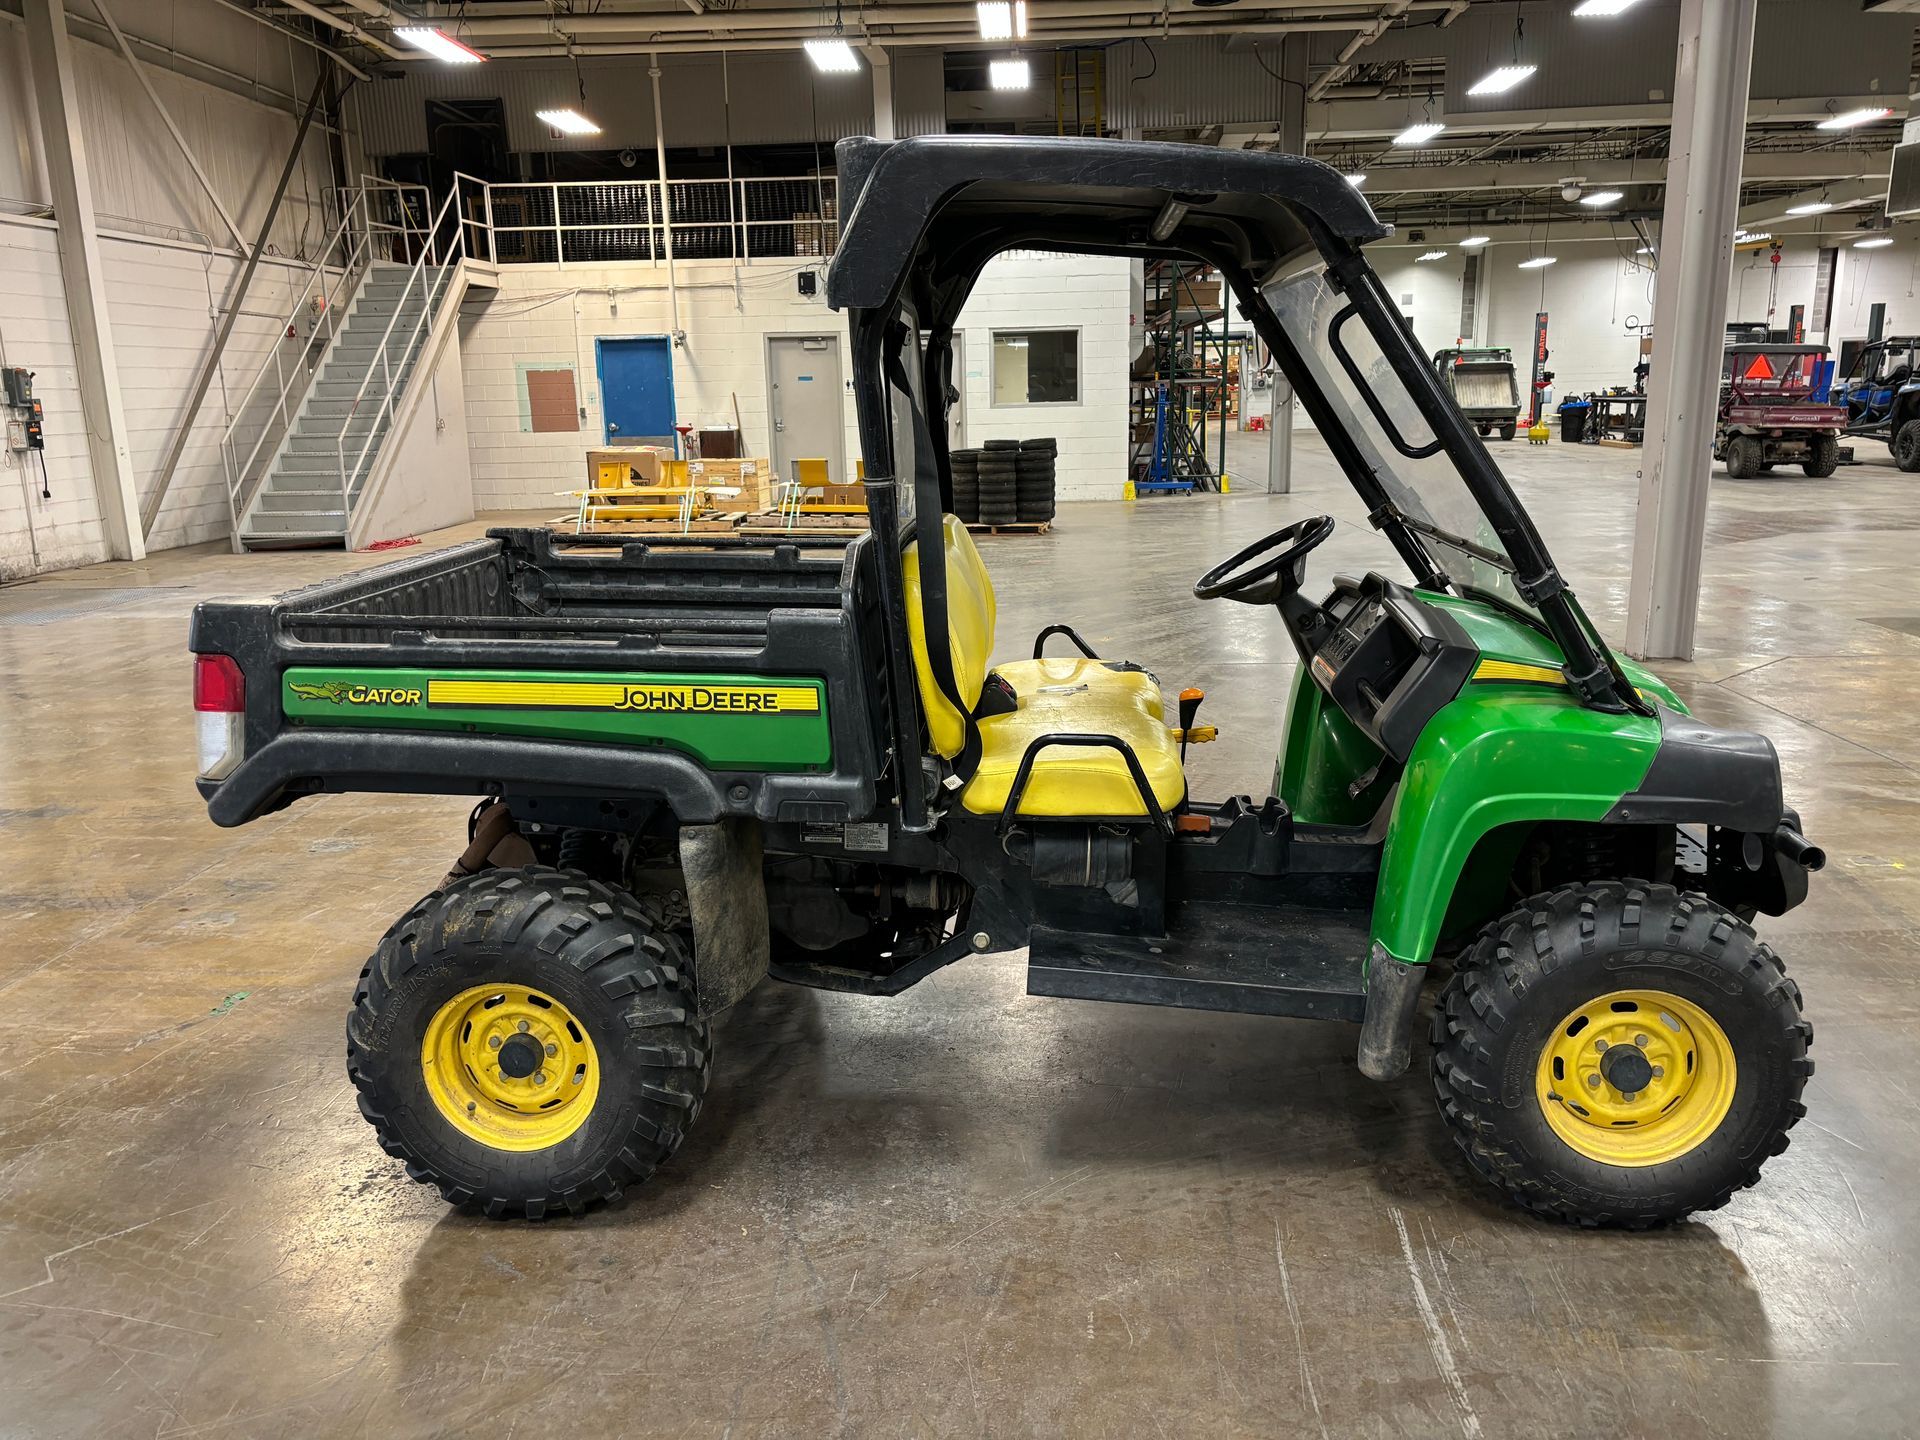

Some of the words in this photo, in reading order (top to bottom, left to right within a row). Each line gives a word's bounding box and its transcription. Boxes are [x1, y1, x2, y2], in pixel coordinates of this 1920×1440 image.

[348, 685, 421, 705] GATOR
[614, 687, 685, 708] JOHN
[692, 688, 779, 710] DEERE
